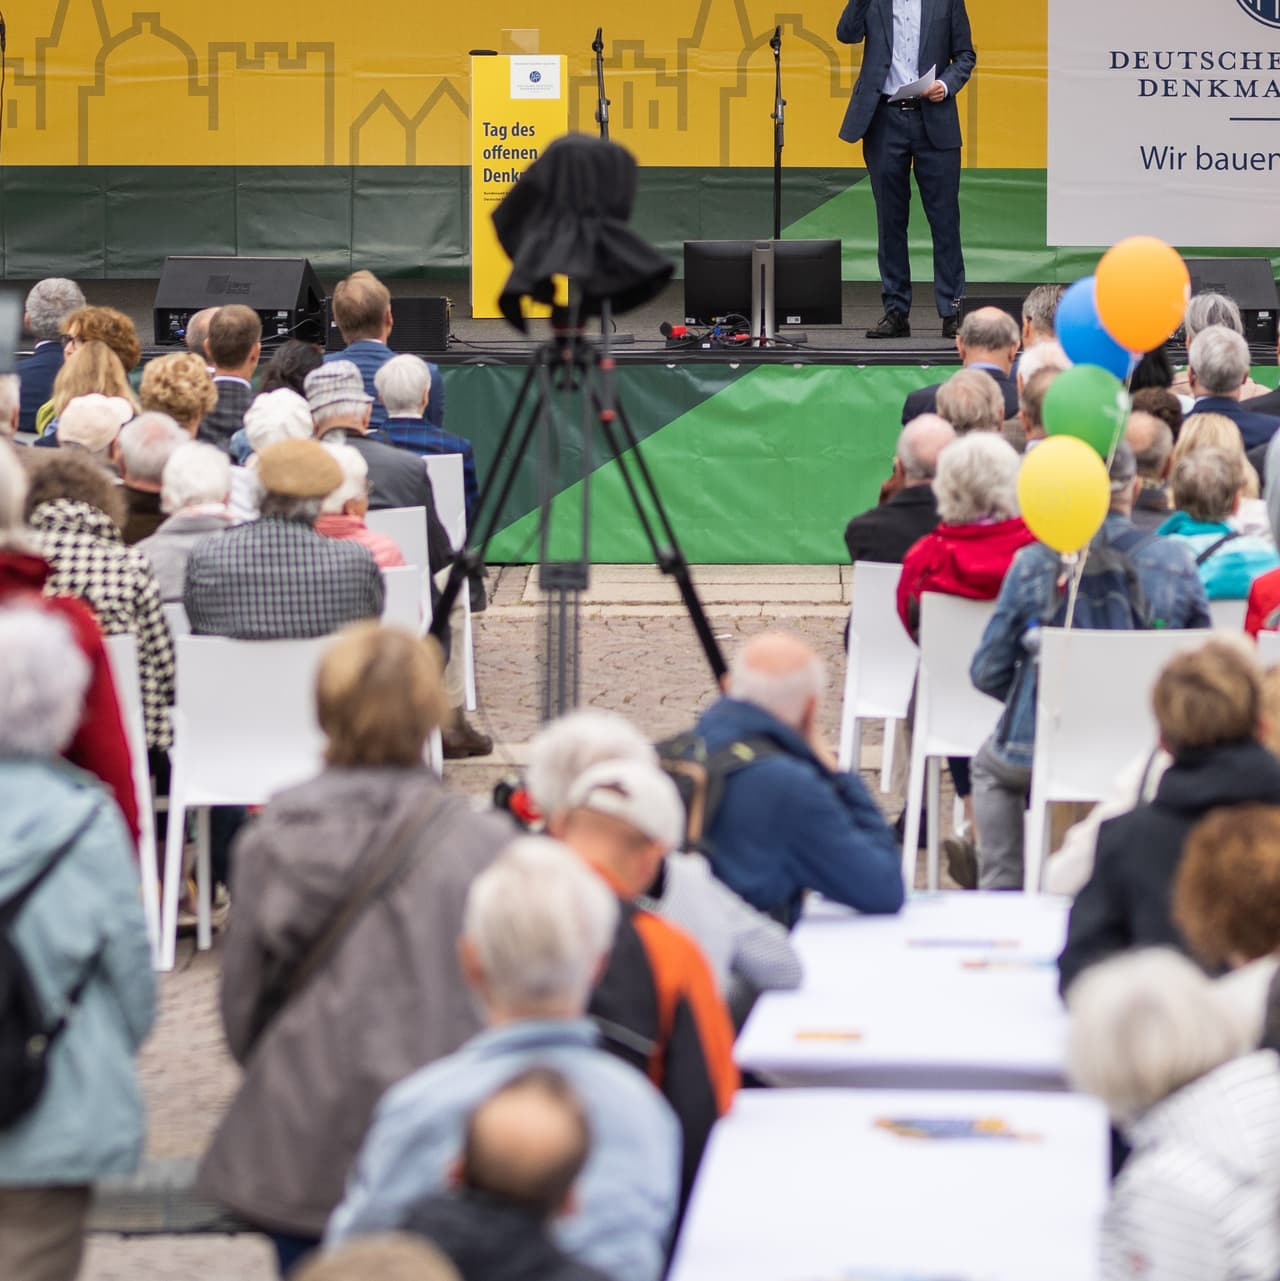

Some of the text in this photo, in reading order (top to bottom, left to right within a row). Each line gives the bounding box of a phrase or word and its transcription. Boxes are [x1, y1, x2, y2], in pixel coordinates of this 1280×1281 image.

[483, 121, 535, 140] Tag des
[483, 144, 538, 160] offenen
[1140, 145, 1187, 171] Wir
